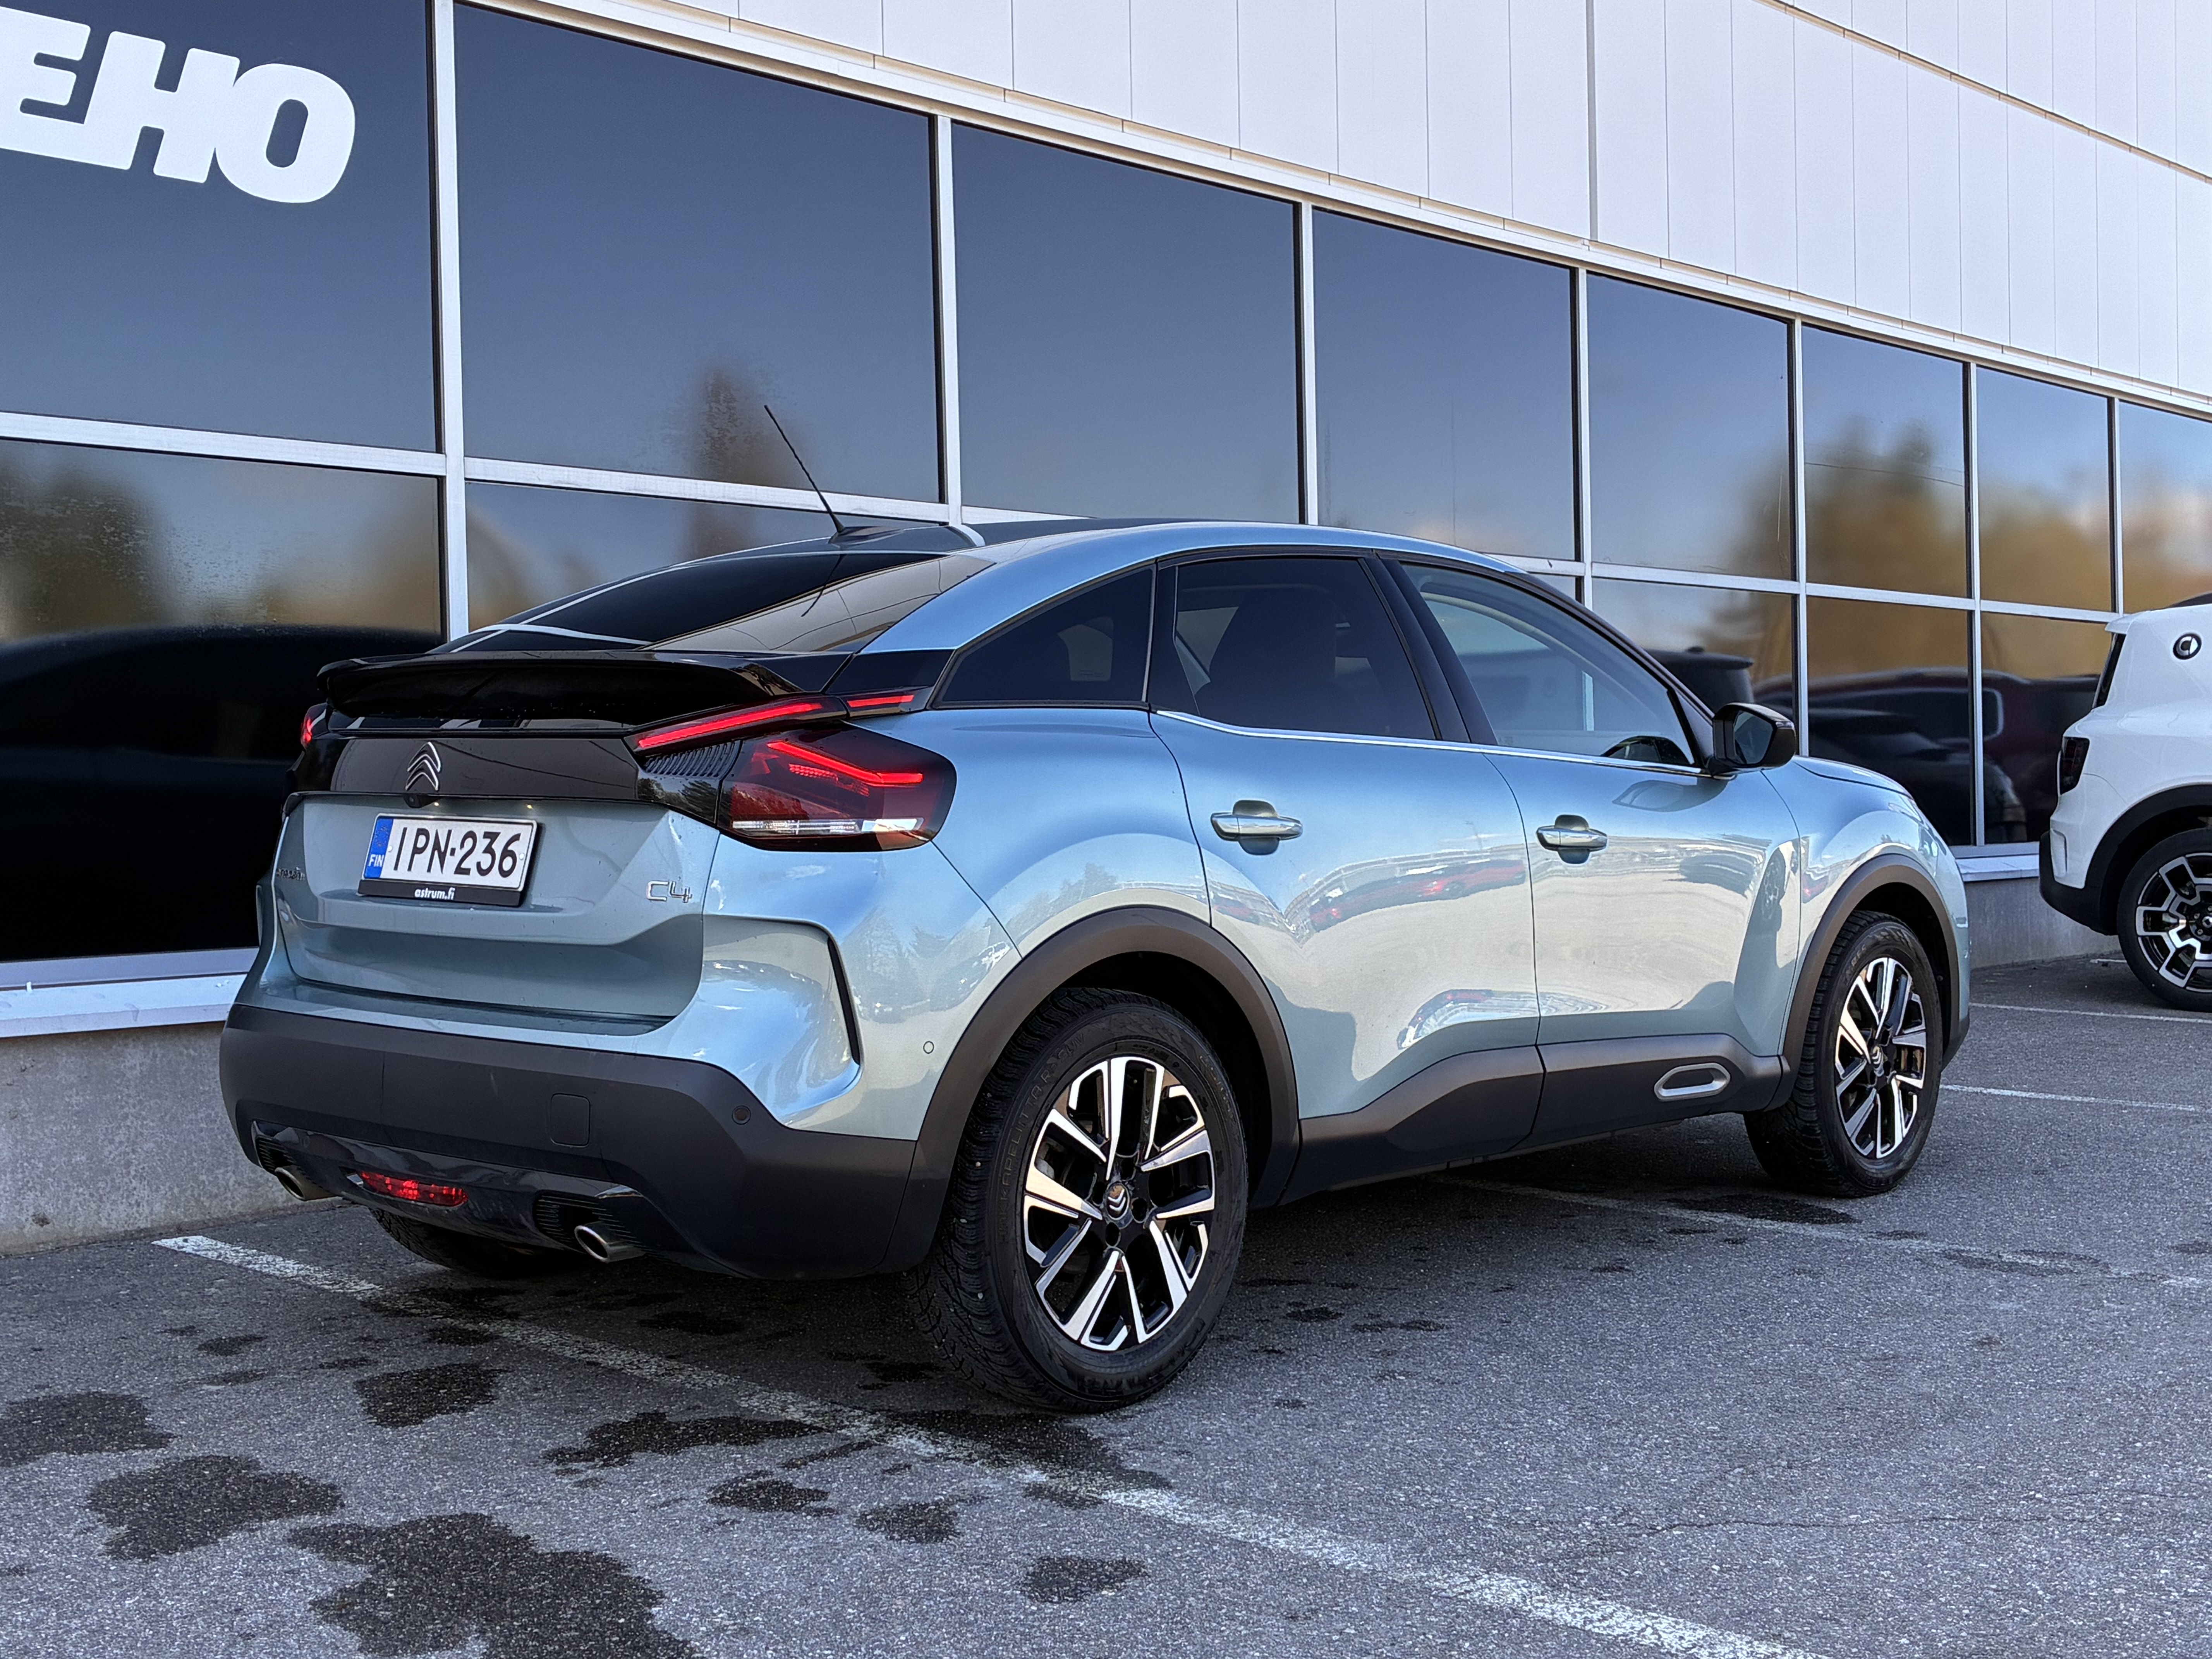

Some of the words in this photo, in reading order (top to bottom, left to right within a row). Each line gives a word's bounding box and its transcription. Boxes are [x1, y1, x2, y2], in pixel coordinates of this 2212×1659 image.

[368, 854, 384, 867] FIN
[393, 827, 521, 878] IPN-236
[414, 888, 455, 900] astrum.fi
[646, 880, 693, 903] C4
